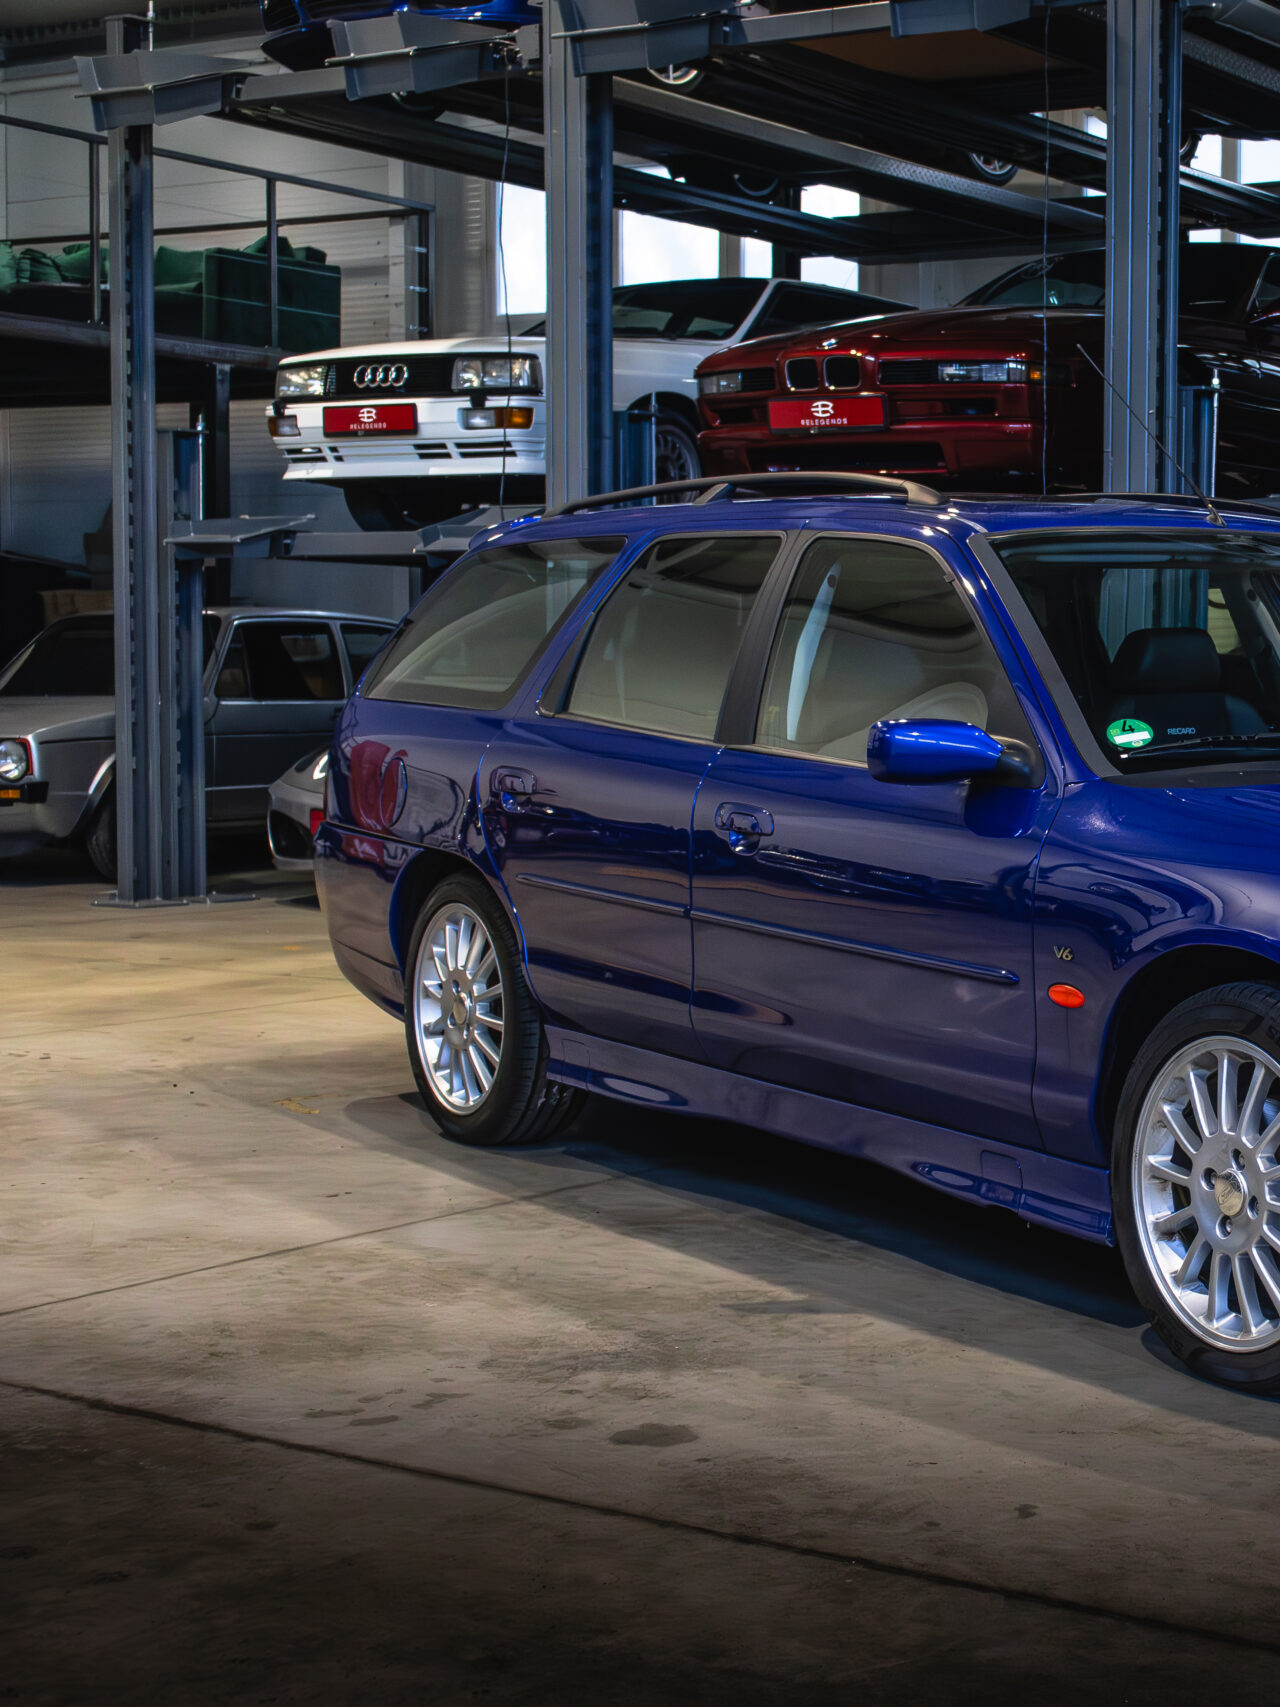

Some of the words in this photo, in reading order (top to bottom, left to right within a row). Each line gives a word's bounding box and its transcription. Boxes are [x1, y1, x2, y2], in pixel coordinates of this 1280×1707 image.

[1122, 720, 1135, 733] 4
[1167, 727, 1196, 735] RECARO
[1053, 945, 1073, 961] V6
